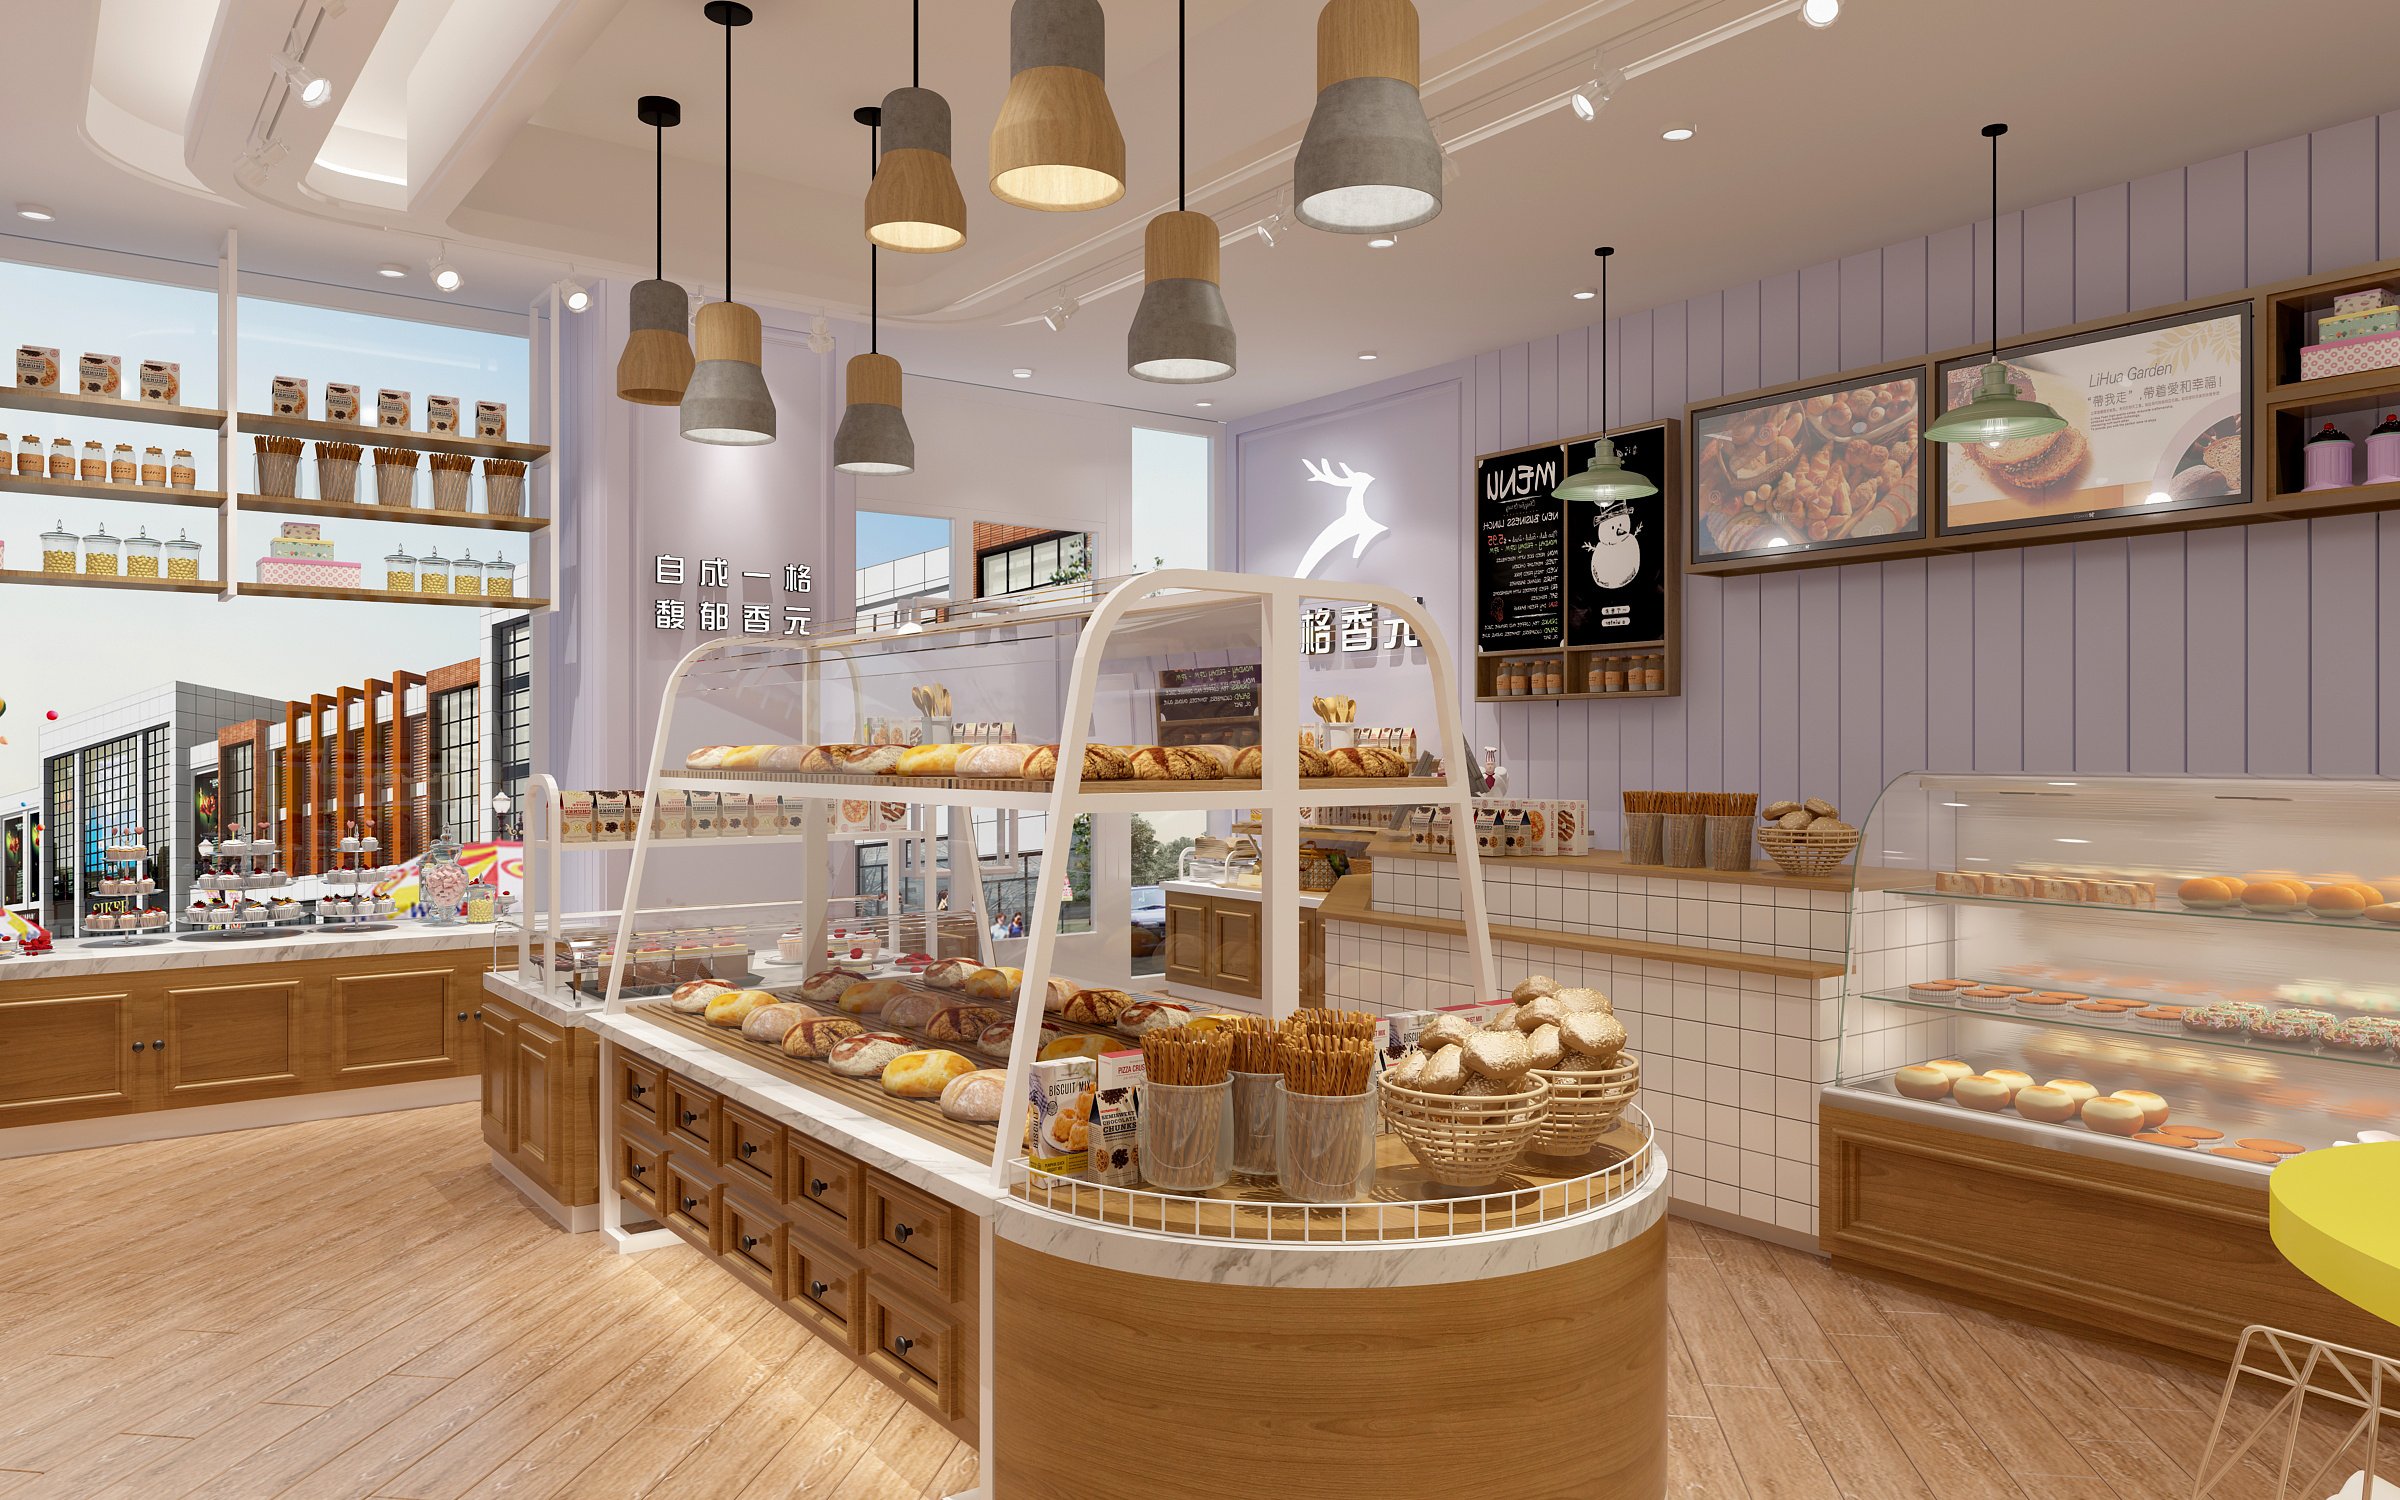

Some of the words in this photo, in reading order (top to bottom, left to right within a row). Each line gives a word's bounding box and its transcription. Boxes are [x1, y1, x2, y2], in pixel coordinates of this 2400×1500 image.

[2089, 371, 2124, 388] LiHua
[2127, 362, 2173, 381] Garden
[655, 554, 811, 593] 自成一格
[655, 599, 811, 636] 馥郁香元
[1117, 1066, 1132, 1074] PIZZA
[1049, 1082, 1075, 1096] BISCUIT
[1079, 1080, 1091, 1092] MIX
[1101, 1111, 1134, 1120] SEMISWEET
[1102, 1116, 1136, 1126] CHOCOLATE
[1103, 1122, 1136, 1133] CHUNKS
